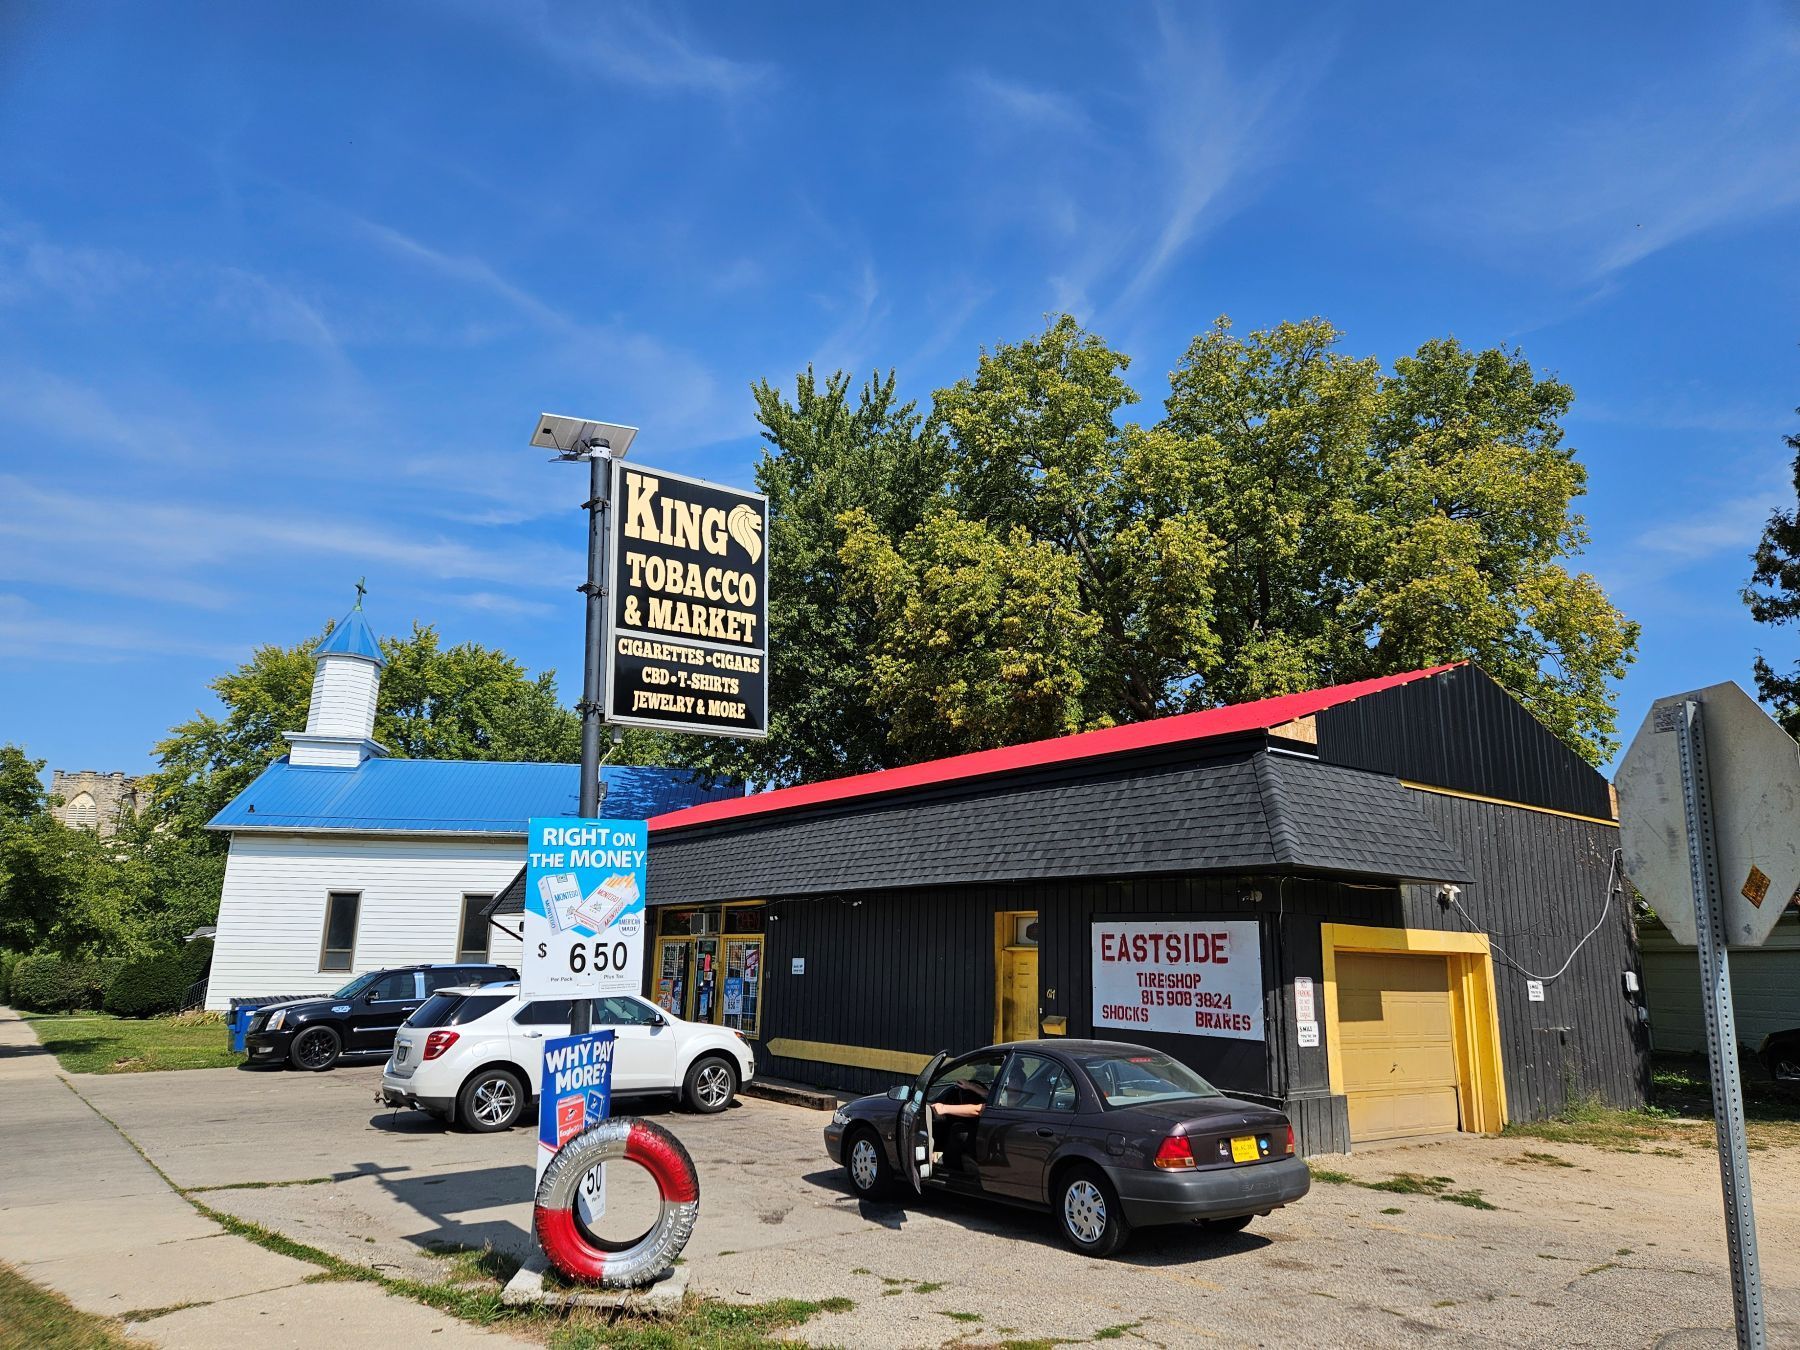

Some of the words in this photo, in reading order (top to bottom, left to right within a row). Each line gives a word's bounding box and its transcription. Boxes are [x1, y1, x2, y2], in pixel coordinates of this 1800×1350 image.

[624, 472, 728, 556] KING
[626, 551, 757, 607] TOBACCO
[624, 595, 641, 626] &
[648, 597, 756, 643] MARKET
[618, 638, 704, 666] CIGARETTES
[713, 655, 760, 674] CIGARS
[642, 666, 669, 684] CBD
[678, 673, 739, 695] T-SHIRTS
[632, 690, 695, 714] JEWELRY
[696, 698, 705, 716] &
[708, 699, 746, 720] MORE
[543, 828, 610, 847] RIGHT
[612, 832, 636, 847] ON
[529, 853, 564, 868] THE
[569, 850, 645, 868] MONEY
[537, 942, 547, 958] $
[569, 941, 628, 976] 6.50
[1101, 933, 1229, 964] EASTSIDE
[1136, 973, 1165, 989] TIRE
[1167, 973, 1201, 989] SHOP
[1141, 990, 1165, 1006] 815
[1167, 991, 1192, 1007] 908
[1195, 993, 1232, 1010] 3824
[1102, 1005, 1149, 1023] SHOCKS
[1195, 1011, 1251, 1032] BRAKES
[545, 1041, 592, 1074] WHY
[592, 1041, 614, 1064] PAY
[555, 1062, 606, 1095] MORE?
